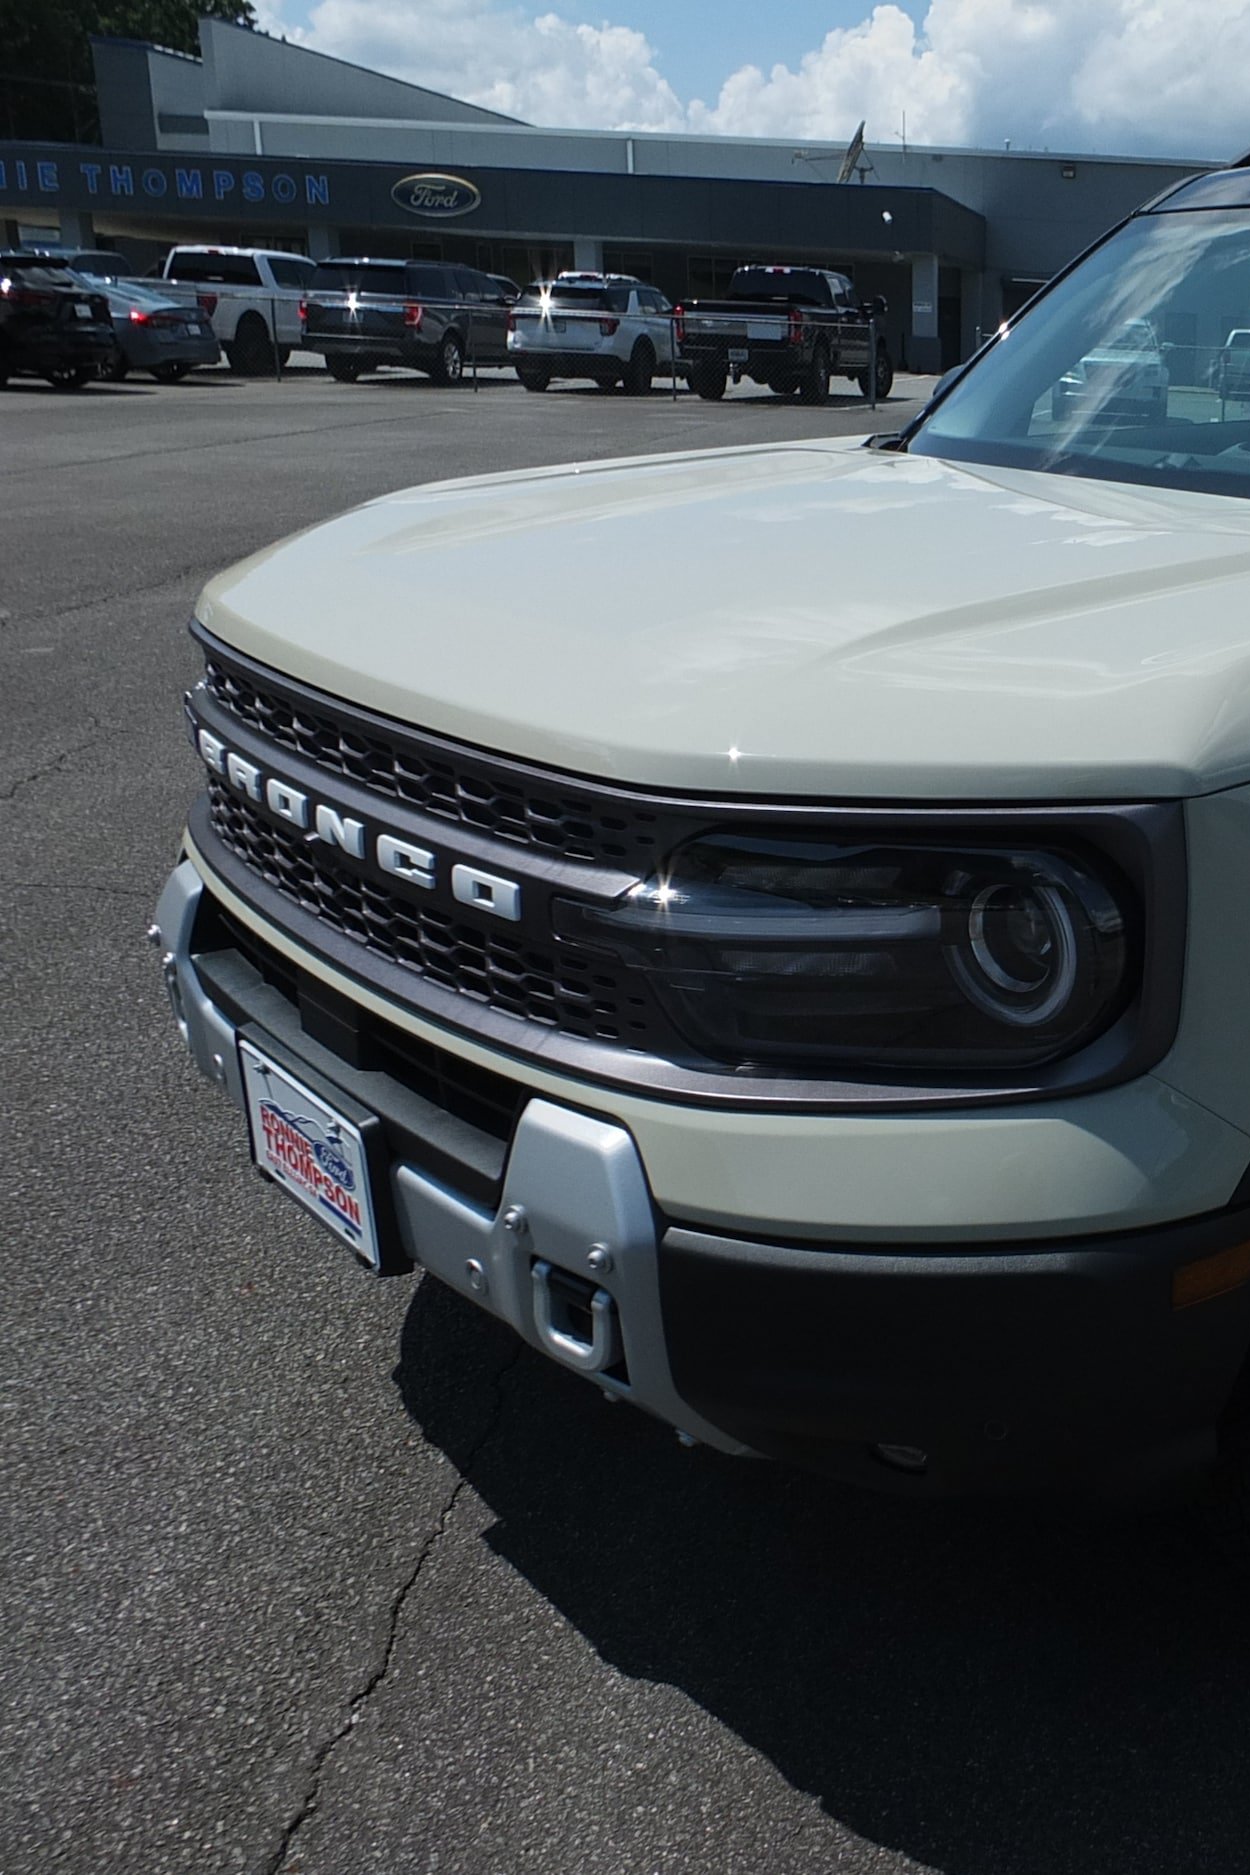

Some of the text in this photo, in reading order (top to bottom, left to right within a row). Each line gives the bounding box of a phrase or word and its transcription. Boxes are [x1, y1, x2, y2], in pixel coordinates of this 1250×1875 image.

[80, 163, 330, 204] THOMPSON
[409, 183, 459, 208] Ford
[199, 728, 521, 922] BRONCO
[260, 1103, 314, 1164] RONNIE
[262, 1123, 361, 1226] THOMPSON
[318, 1144, 350, 1186] Ford
